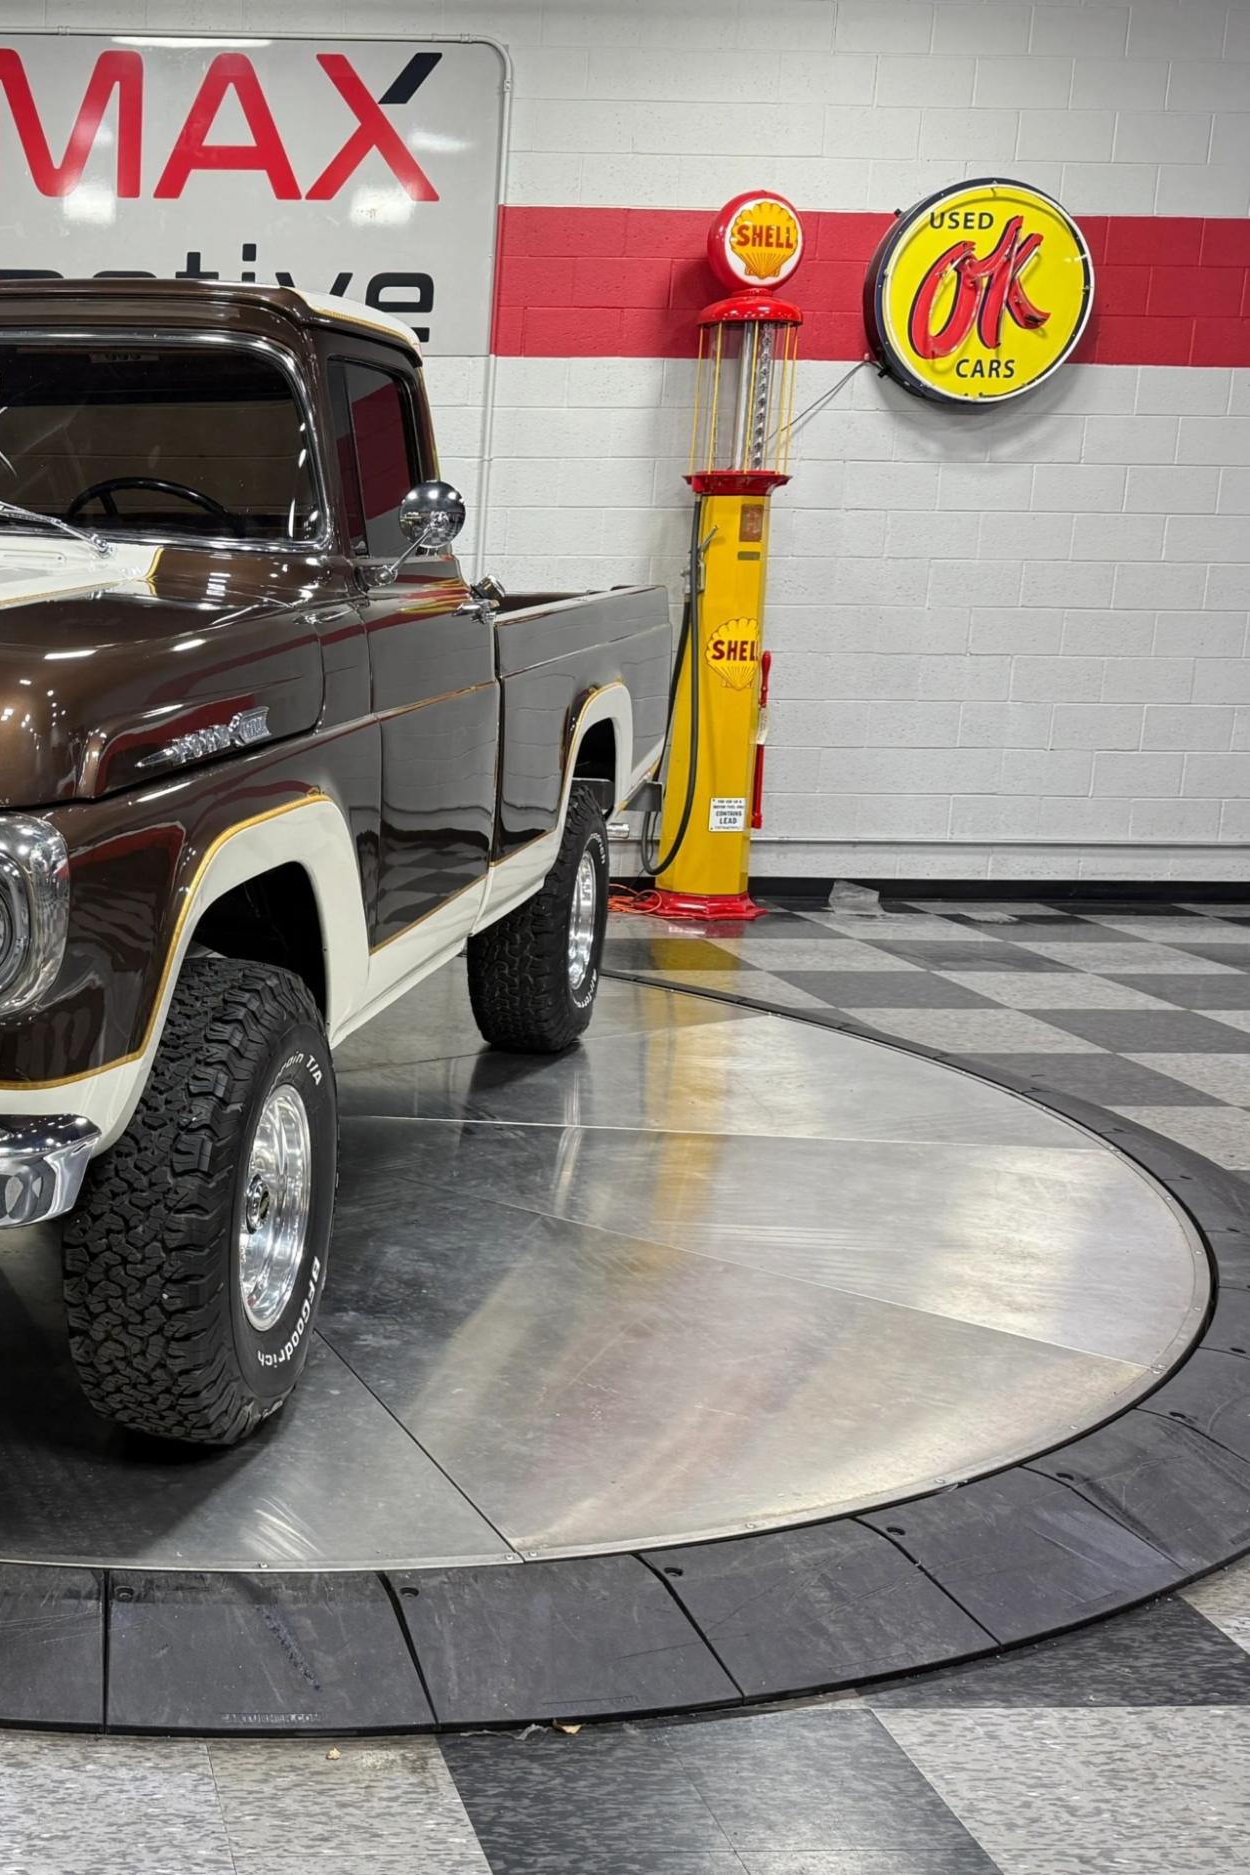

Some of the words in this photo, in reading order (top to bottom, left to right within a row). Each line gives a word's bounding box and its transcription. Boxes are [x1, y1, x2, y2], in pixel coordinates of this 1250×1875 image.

[930, 211, 995, 231] USED
[735, 224, 795, 250] SHELL
[907, 215, 1051, 360] OK
[955, 359, 1016, 379] CARS
[306, 1054, 323, 1086] T/A
[257, 1255, 321, 1369] BFGoodrich
